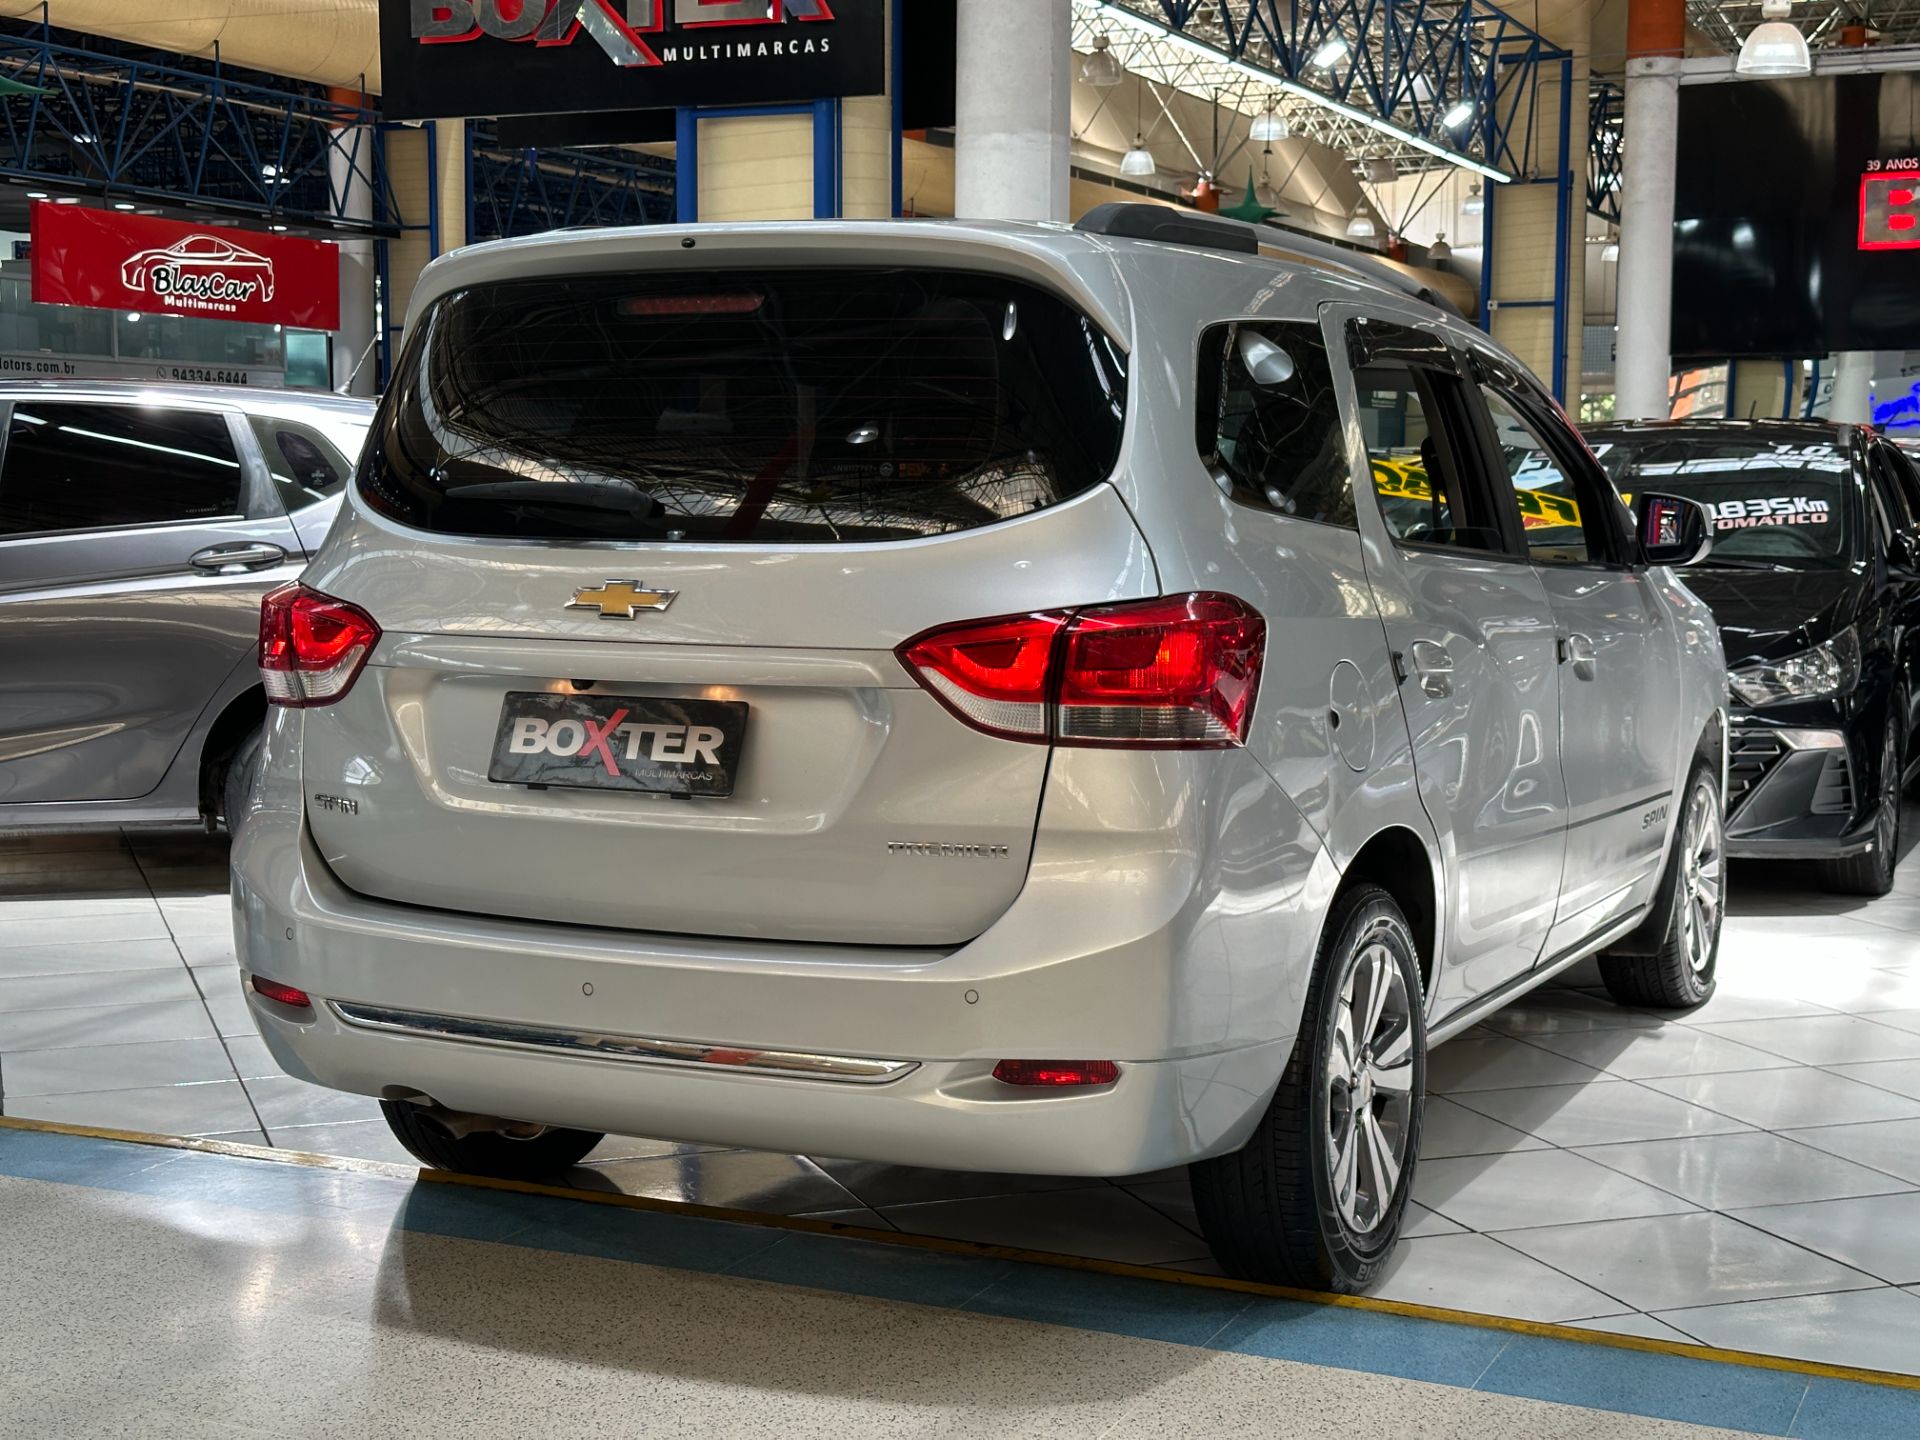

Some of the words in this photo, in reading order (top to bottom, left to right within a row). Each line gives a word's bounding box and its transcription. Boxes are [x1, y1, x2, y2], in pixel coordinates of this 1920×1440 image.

[663, 38, 831, 62] MULTIMARCAS
[1867, 160, 1881, 171] 39
[1886, 158, 1919, 170] ANOS
[152, 265, 256, 302] BlasCar
[164, 295, 237, 312] Multimarcas
[1710, 512, 1829, 531] OMATICO
[509, 708, 725, 777] BOXTER
[634, 767, 713, 782] MULTIMARCAS
[1642, 803, 1669, 830] SPIN
[887, 841, 1008, 859] PREMIER
